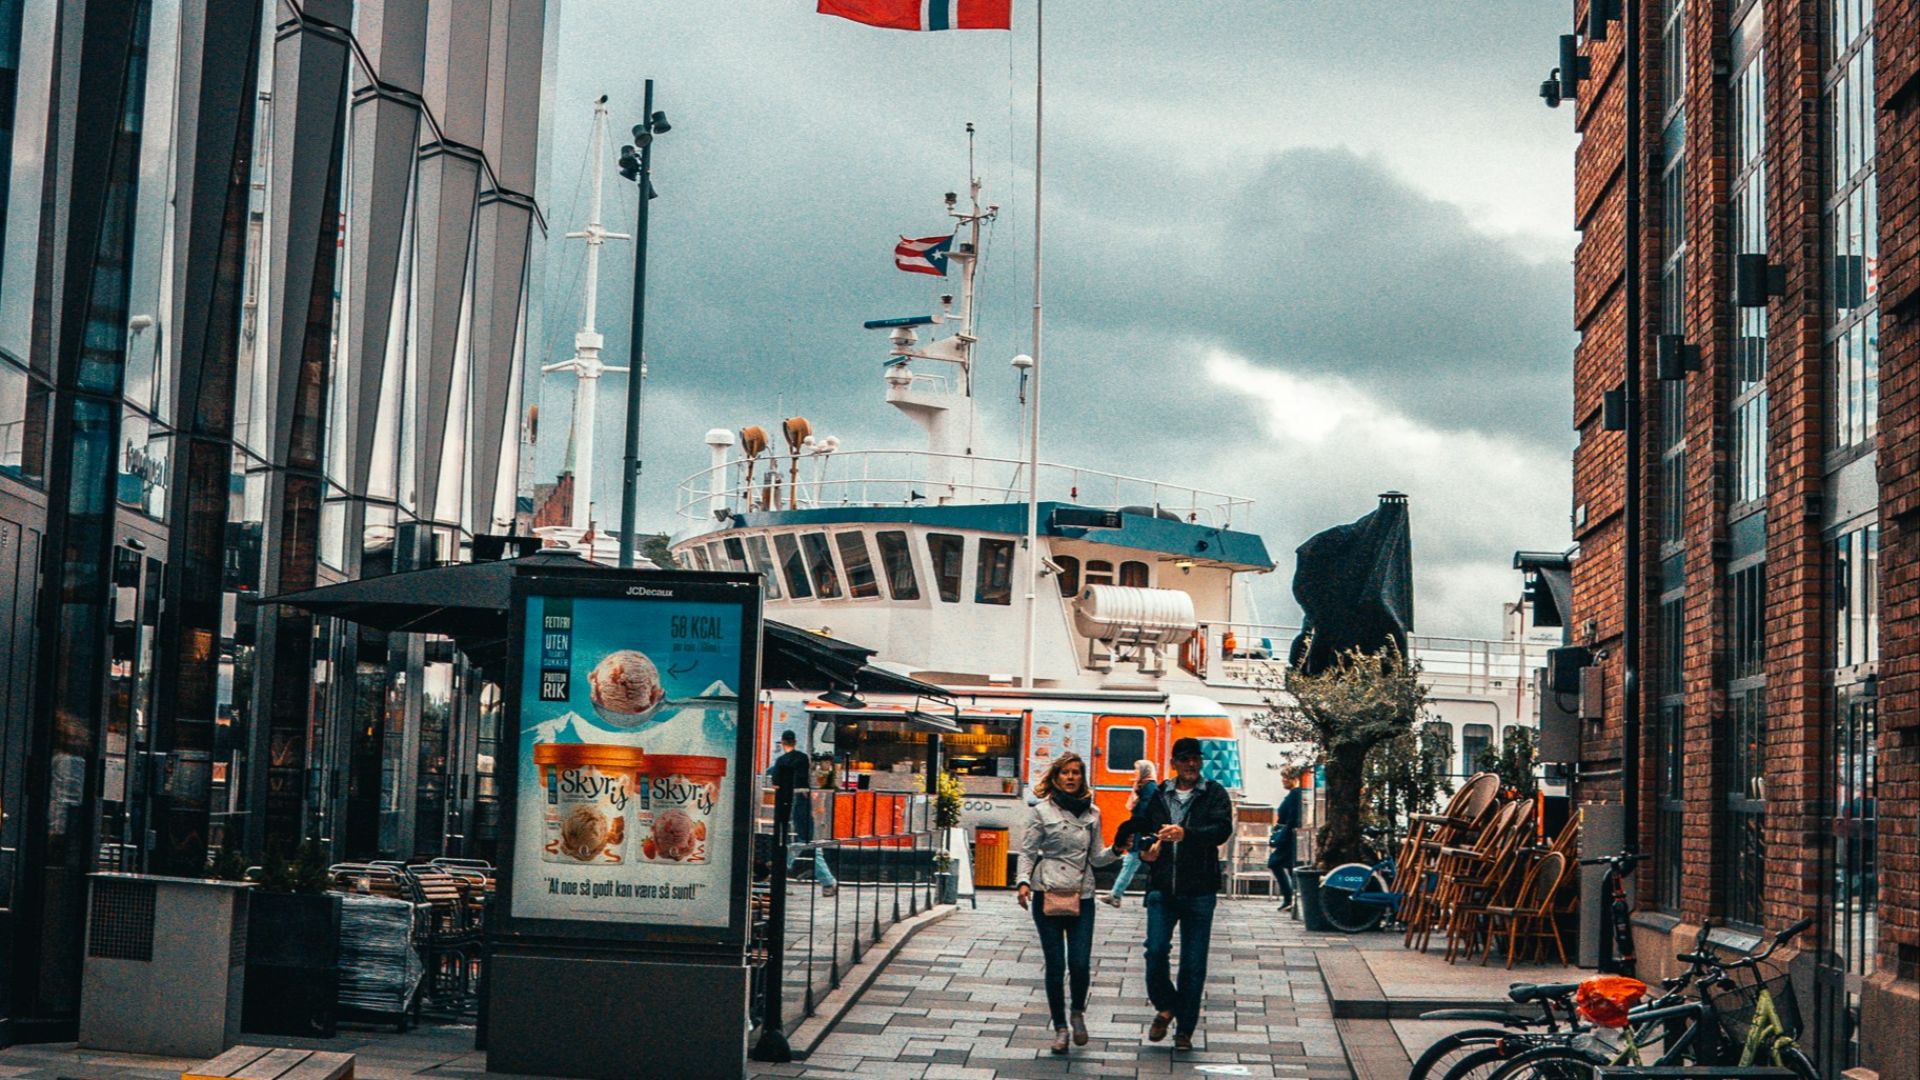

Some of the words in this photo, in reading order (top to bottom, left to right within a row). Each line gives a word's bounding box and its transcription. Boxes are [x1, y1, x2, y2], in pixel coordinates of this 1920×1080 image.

[625, 586, 673, 597] JCDecaux
[671, 614, 688, 639] 58
[691, 615, 723, 640] KCAL
[545, 634, 568, 650] UTEN
[543, 682, 566, 699] RIK
[561, 880, 578, 896] noe
[579, 879, 591, 897] så
[592, 880, 614, 899] godt
[615, 880, 632, 898] kan
[634, 884, 656, 899] være
[658, 882, 671, 900] så
